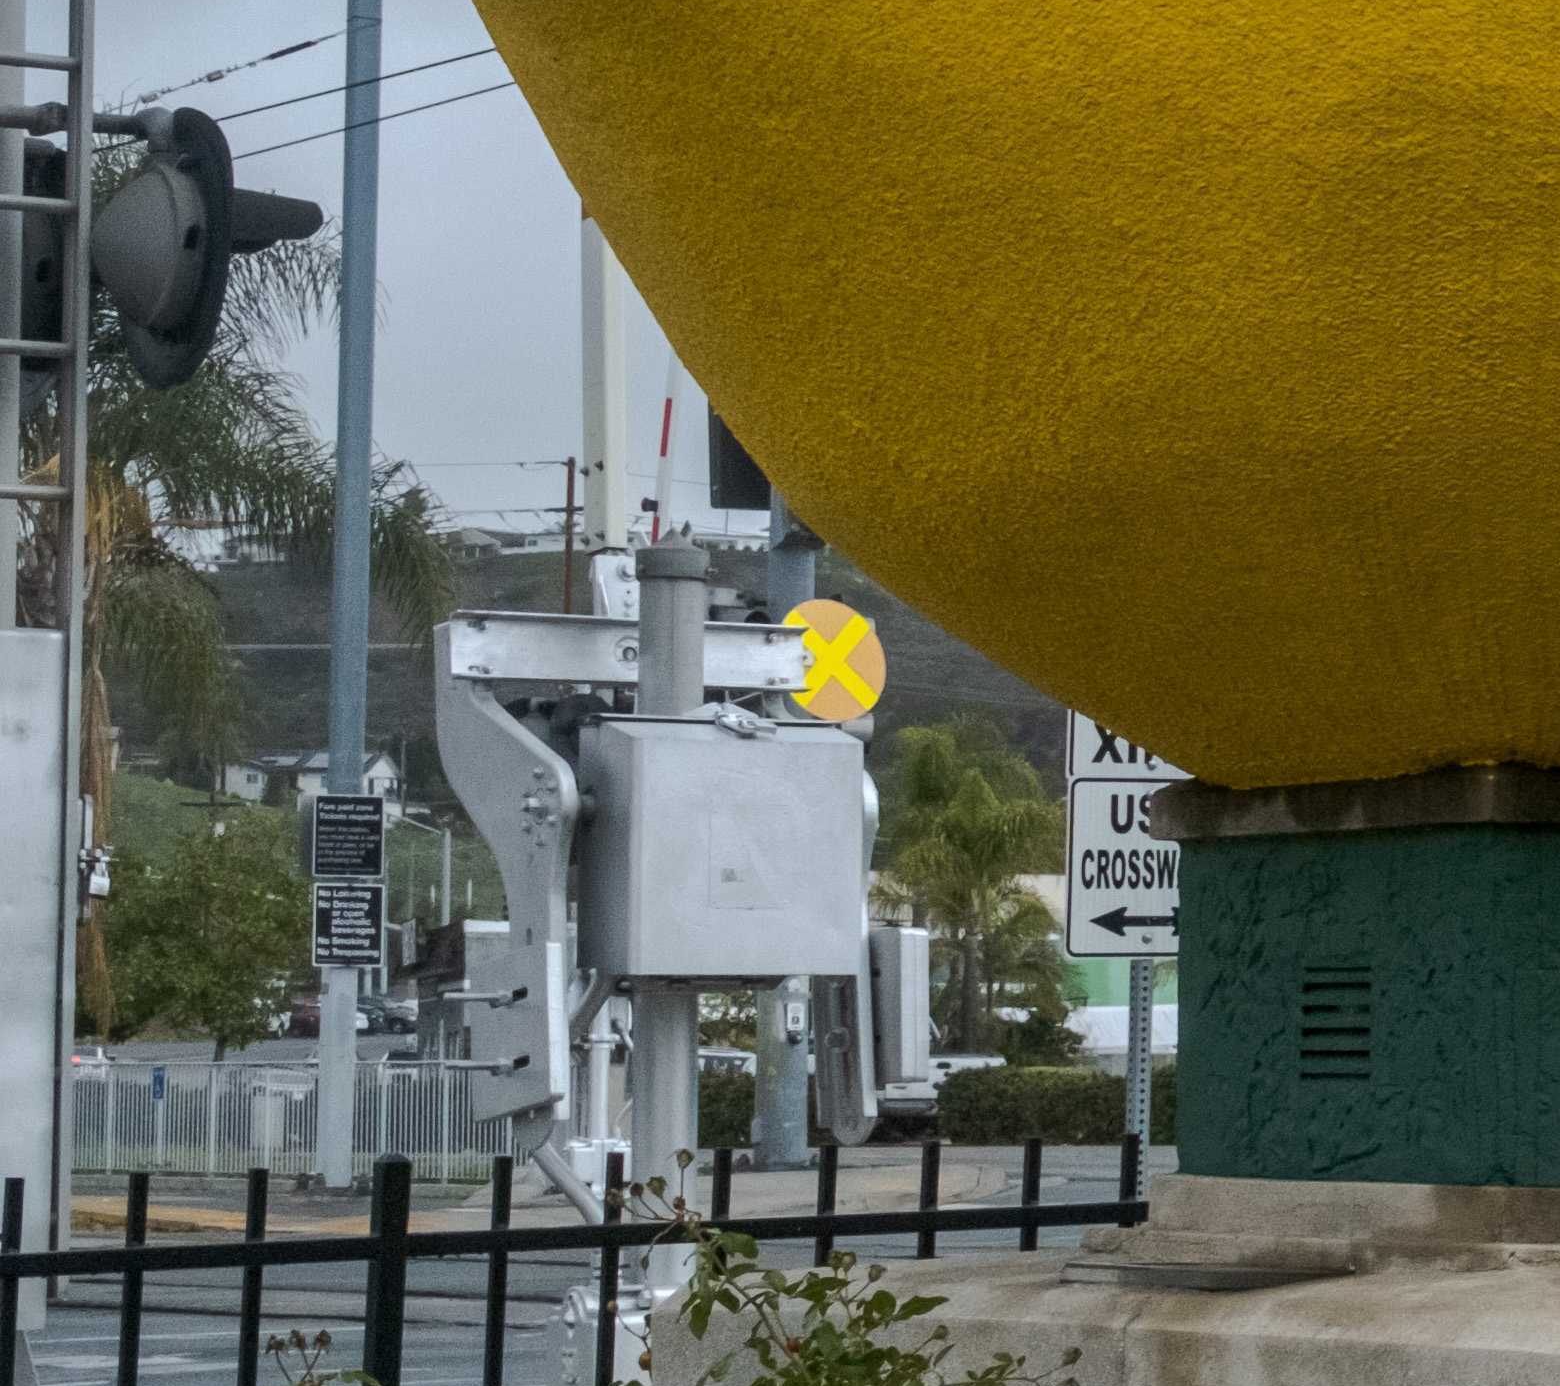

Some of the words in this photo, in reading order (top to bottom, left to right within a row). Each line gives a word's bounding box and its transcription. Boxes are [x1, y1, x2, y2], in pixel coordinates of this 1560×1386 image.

[1111, 794, 1152, 834] US
[1081, 849, 1179, 889] CROSSW
[318, 900, 331, 908] No
[317, 936, 330, 945] No
[316, 947, 330, 956] No
